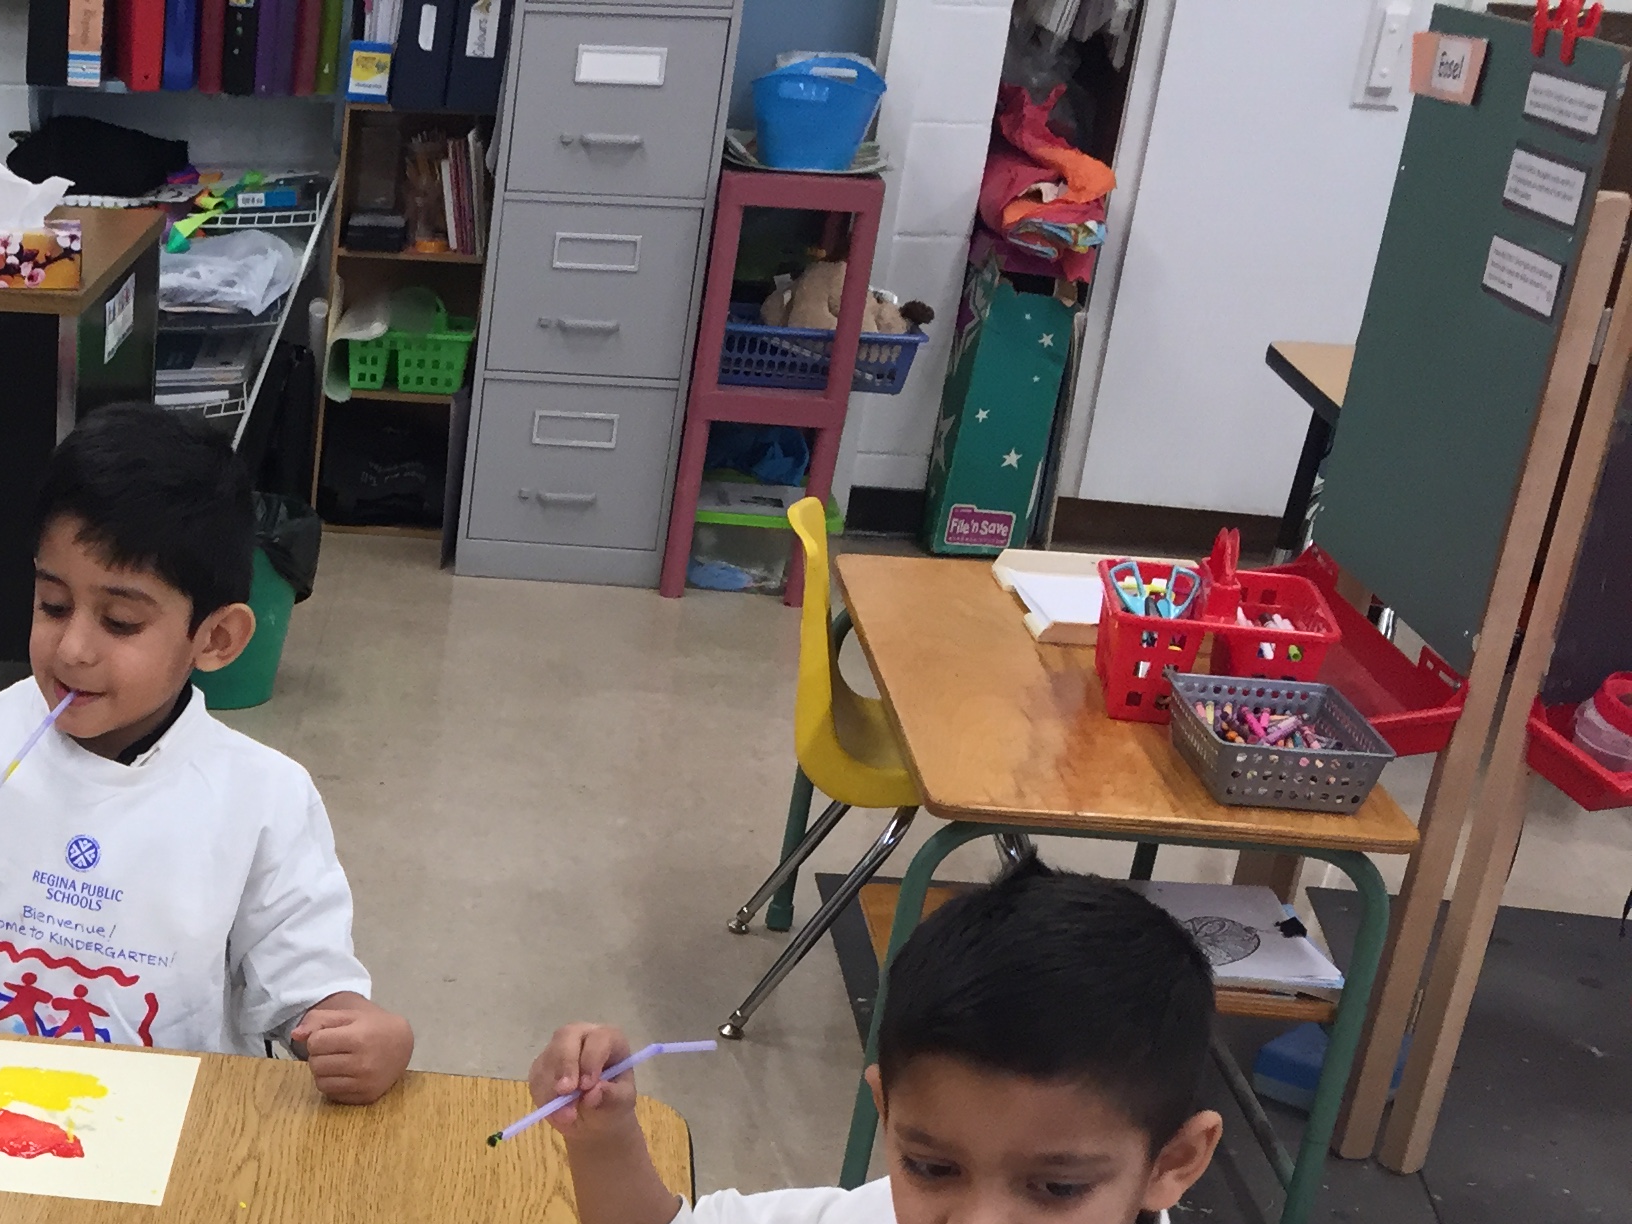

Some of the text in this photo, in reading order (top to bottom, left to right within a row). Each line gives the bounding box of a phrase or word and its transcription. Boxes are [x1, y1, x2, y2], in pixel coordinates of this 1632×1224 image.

[949, 518, 970, 535] File
[979, 520, 1008, 537] Save
[32, 869, 124, 902] REGINA PUBLIC
[45, 887, 103, 912] SCHOOLS
[28, 925, 45, 941] to
